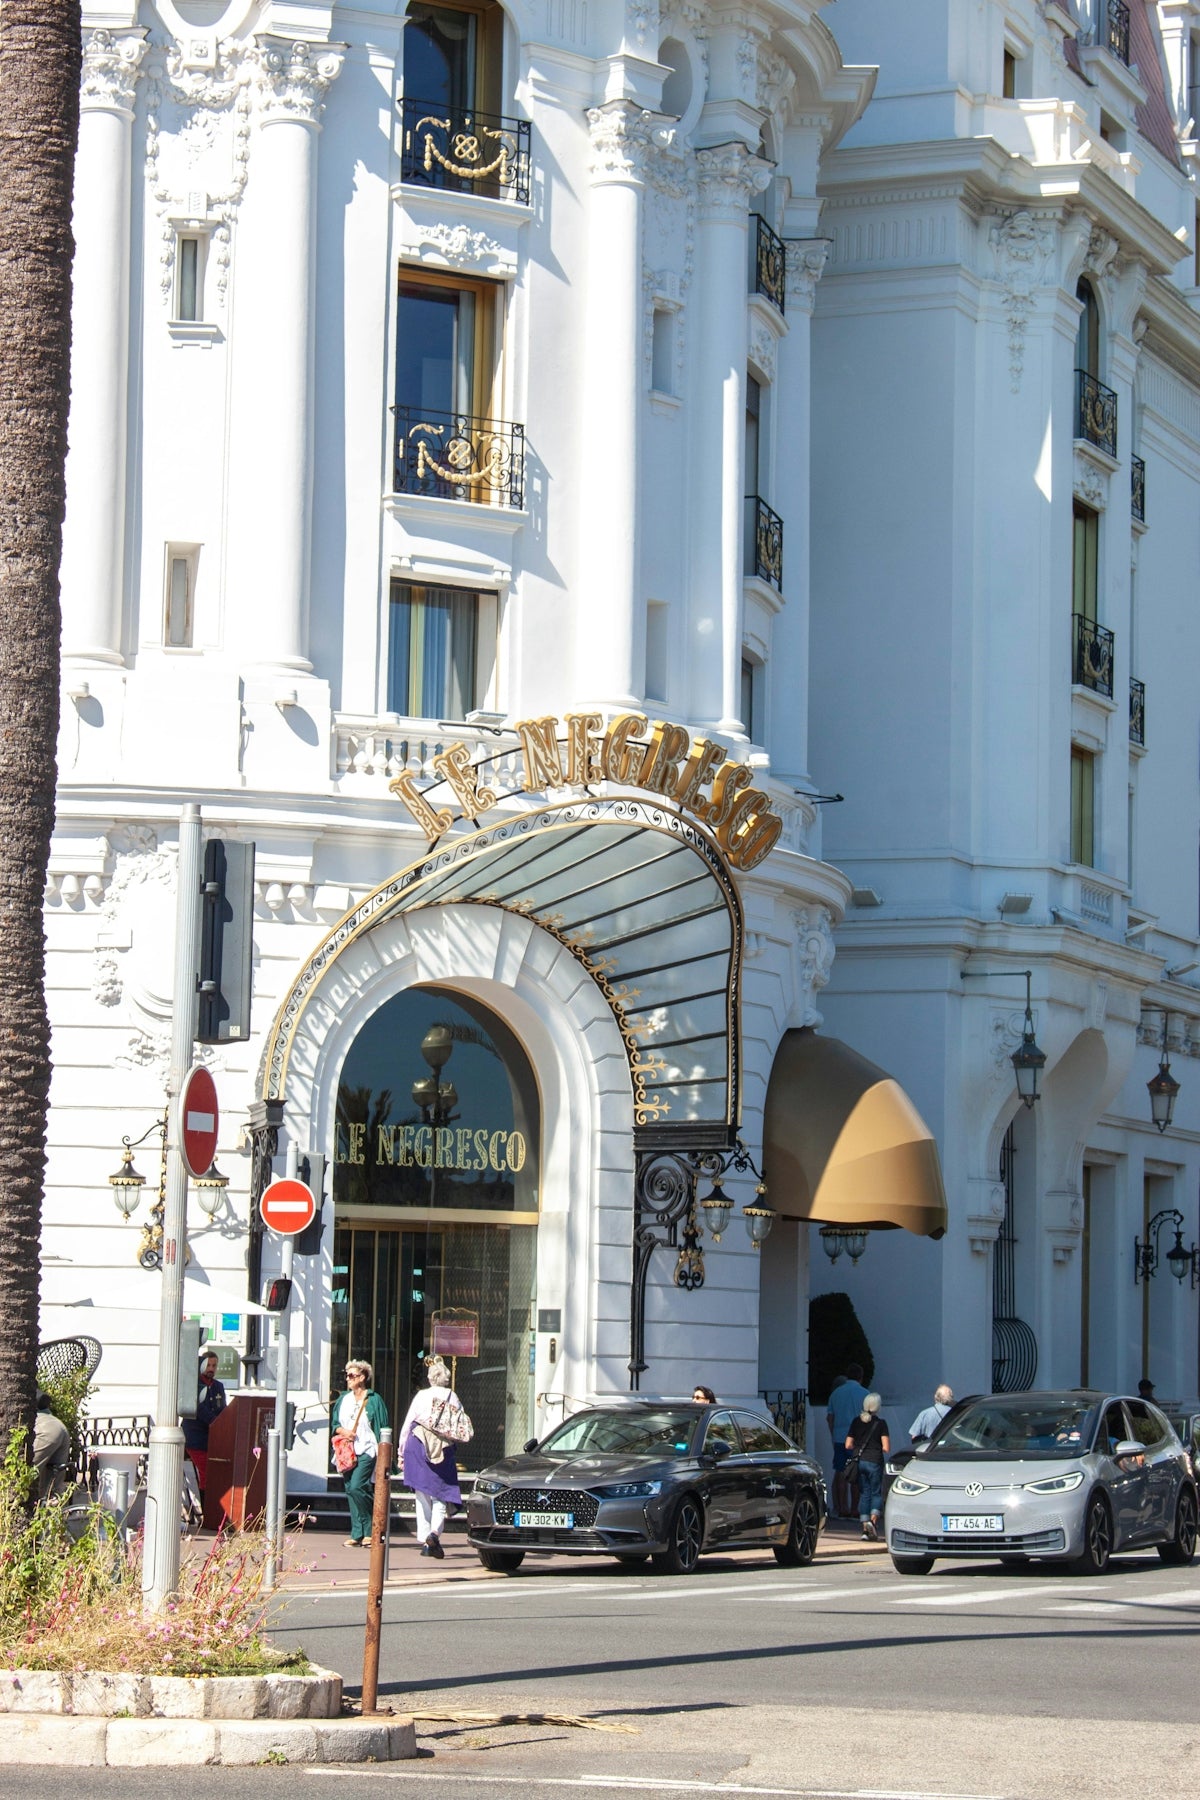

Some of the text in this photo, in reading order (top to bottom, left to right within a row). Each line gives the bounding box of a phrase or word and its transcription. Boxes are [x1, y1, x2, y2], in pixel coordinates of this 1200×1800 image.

[389, 712, 783, 872] LE NEGRESCO
[333, 1122, 527, 1172] LE NEGRESCO
[223, 1351, 234, 1364] H
[949, 1518, 995, 1529] FT-454-AE
